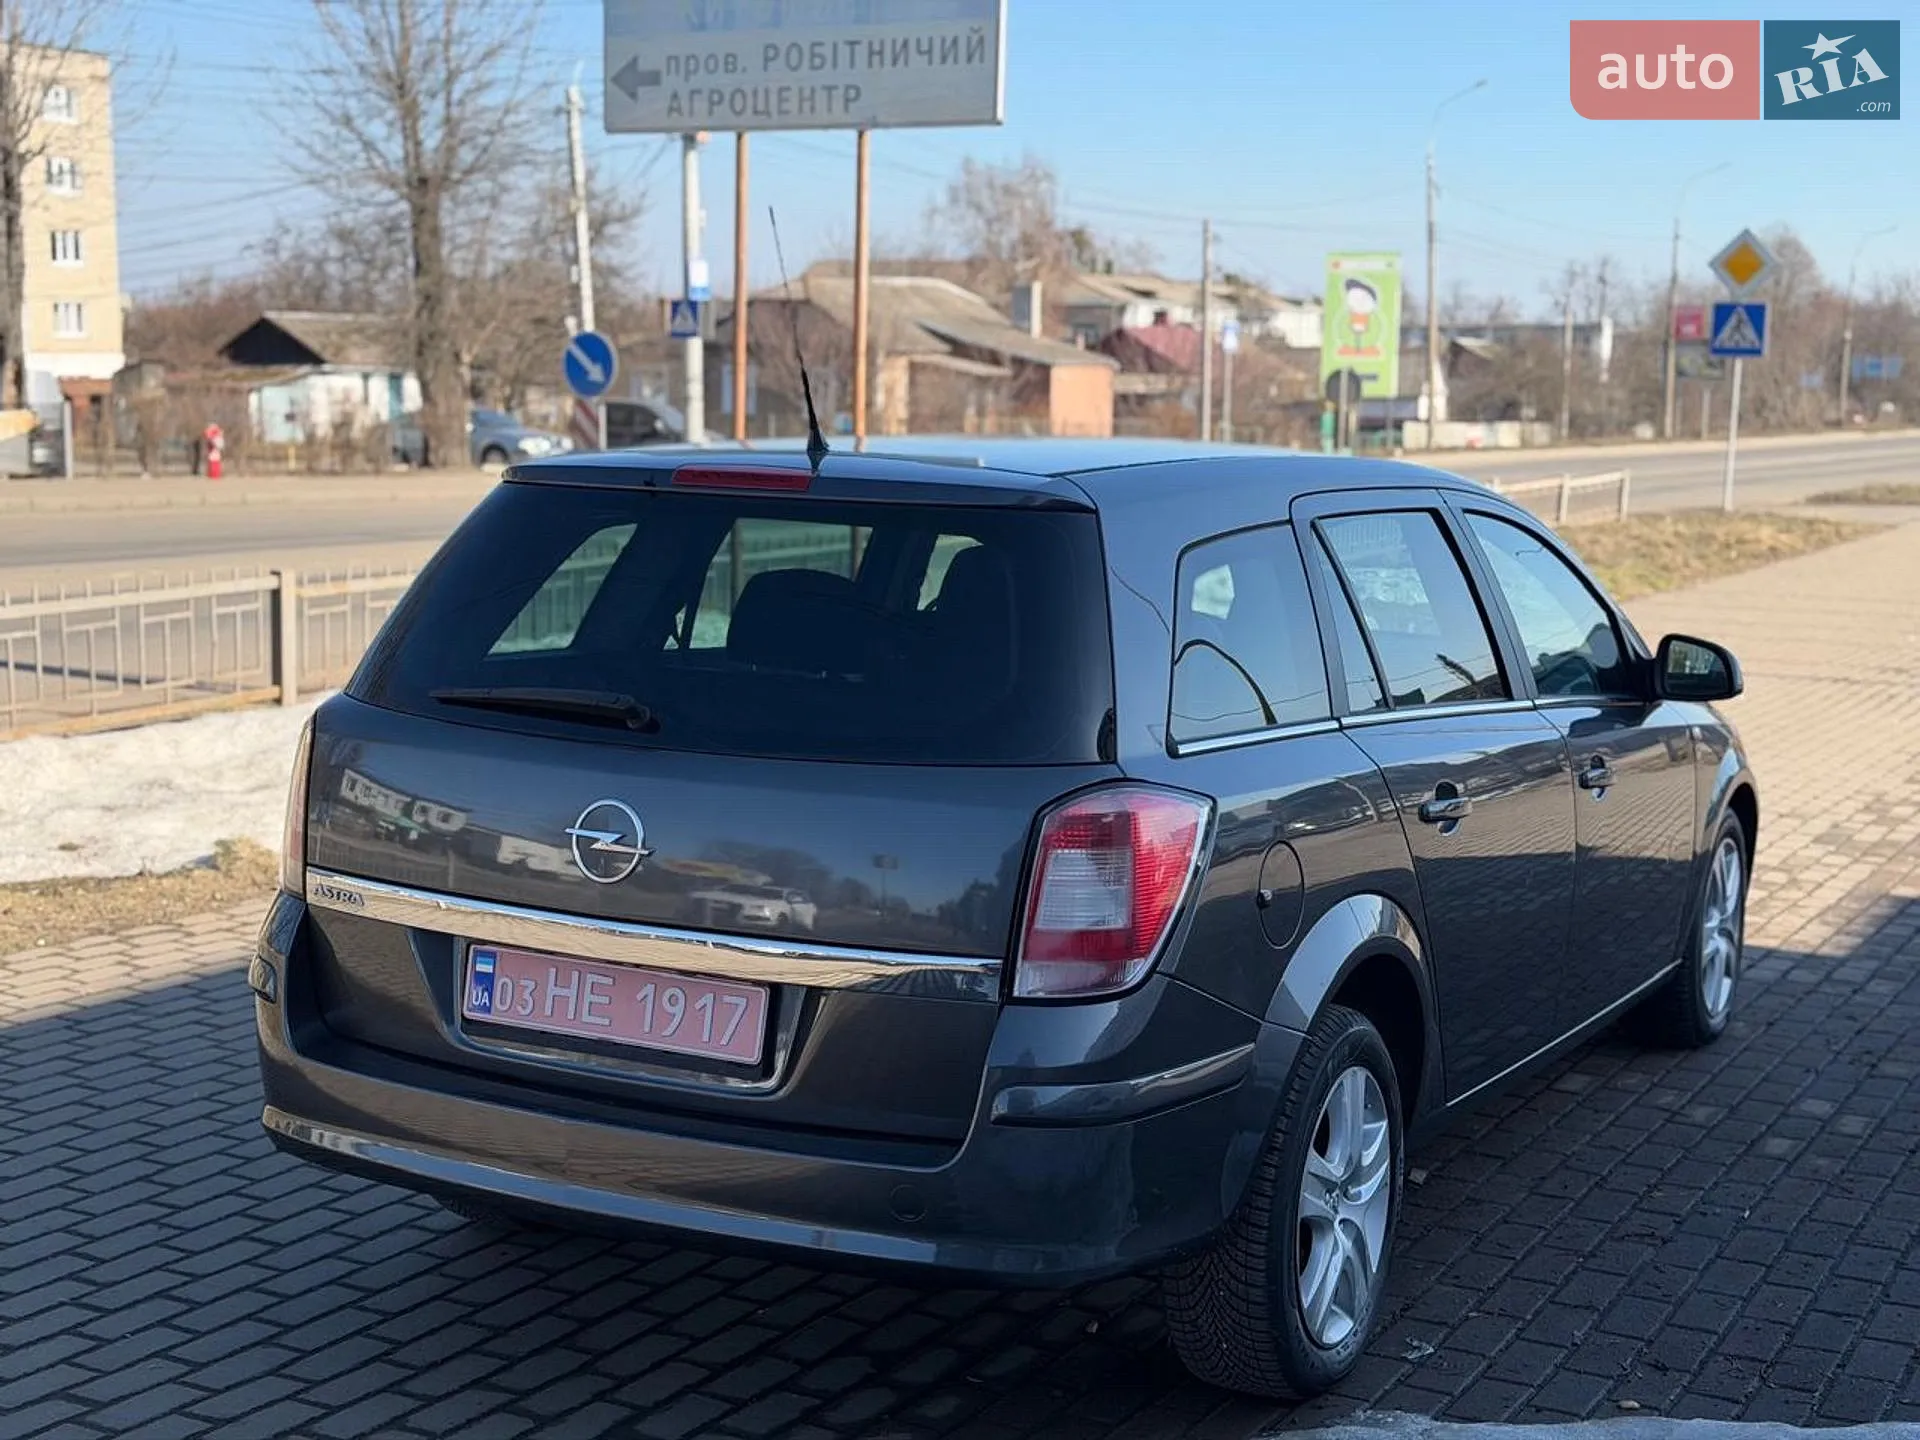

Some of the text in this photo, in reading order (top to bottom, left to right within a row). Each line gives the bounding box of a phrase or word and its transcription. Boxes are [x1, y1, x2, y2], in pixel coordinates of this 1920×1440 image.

[666, 27, 985, 82] пров. РОБІТНИЧИЙ
[667, 84, 862, 118] АГРОЦЕНТР
[312, 883, 366, 907] ASTRA
[472, 986, 491, 1007] UA
[496, 967, 748, 1046] 03 HE 1917
